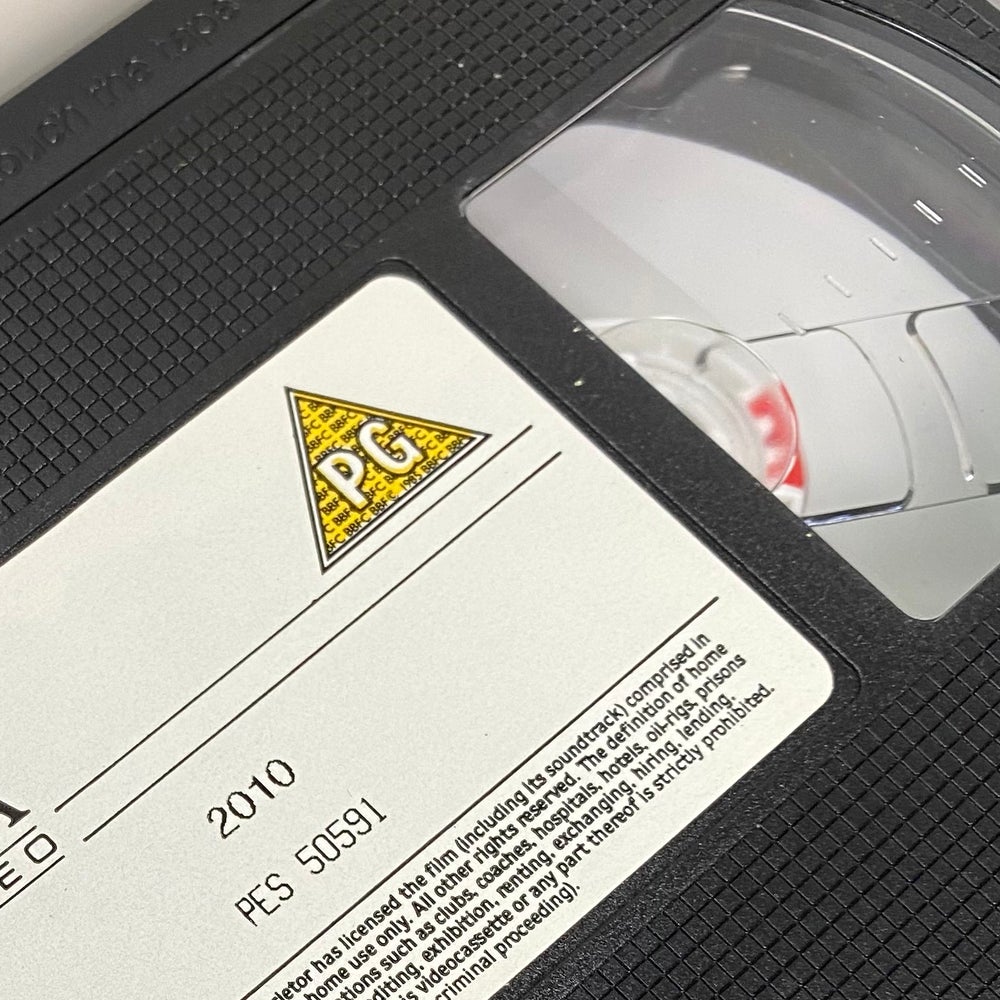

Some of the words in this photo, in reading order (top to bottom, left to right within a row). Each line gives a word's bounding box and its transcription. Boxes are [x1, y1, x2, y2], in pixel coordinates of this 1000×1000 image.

[315, 418, 426, 511] PG
[207, 759, 295, 839] 2010
[234, 873, 294, 927] PES
[295, 798, 387, 875] 50591
[308, 945, 344, 975] has
[336, 893, 404, 952] licensed
[396, 873, 429, 901] the
[423, 848, 460, 879] film
[453, 788, 531, 855] (including
[520, 772, 549, 796] its
[543, 702, 630, 779] soundtrack)
[624, 642, 697, 709] comprised
[689, 632, 712, 651] in
[346, 942, 379, 971] use
[374, 914, 415, 948] only.
[410, 890, 438, 919] All
[432, 858, 475, 899] other
[471, 822, 521, 866] rights
[515, 770, 583, 829] reserved.
[574, 746, 609, 773] The
[605, 690, 676, 751] definition
[671, 672, 690, 695] of
[684, 642, 729, 681] home
[378, 937, 419, 973] such
[413, 920, 437, 942] as
[694, 653, 748, 704] prisons
[413, 908, 515, 995] videocassette
[510, 892, 531, 914] or
[527, 869, 560, 900] any
[554, 842, 592, 880] part
[585, 795, 641, 848] thereof
[634, 786, 656, 804] is
[651, 743, 705, 793] strictly
[700, 682, 776, 752] prohibited.
[492, 880, 582, 960] proceeding).
